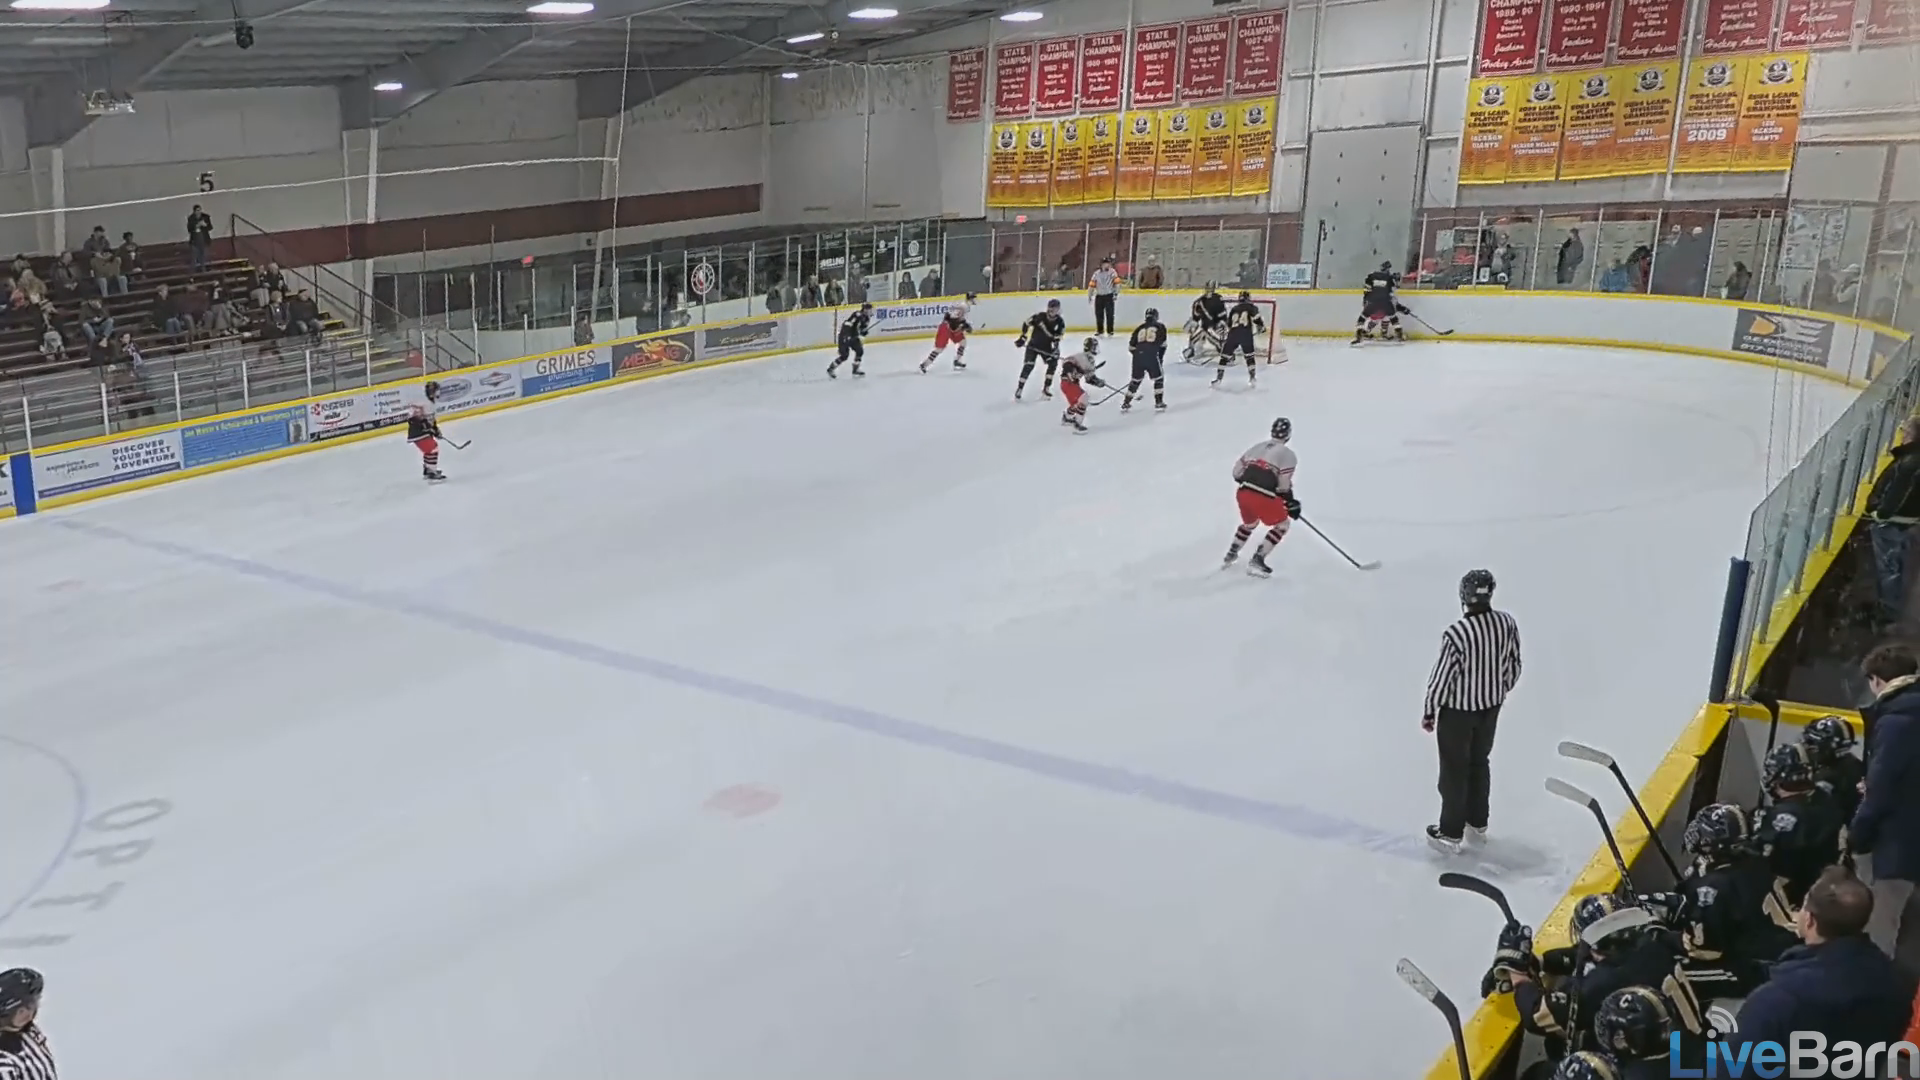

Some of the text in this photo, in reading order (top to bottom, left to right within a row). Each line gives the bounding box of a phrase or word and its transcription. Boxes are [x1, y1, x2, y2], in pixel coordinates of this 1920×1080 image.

[1247, 16, 1274, 27] STATE
[1196, 24, 1219, 33] STATE
[1239, 24, 1281, 38] CHAMPION
[1718, 21, 1756, 35] Jackson
[1146, 30, 1169, 41] STATE
[1188, 32, 1226, 44] CHAMPION
[1631, 29, 1666, 41] Jackson
[1782, 31, 1817, 42] Hockey
[1092, 36, 1114, 46] STATE
[1138, 40, 1176, 51] CHAMPION
[1561, 37, 1594, 50] Jackson
[1704, 38, 1738, 49] Hockey
[1004, 47, 1026, 57] STATE
[1046, 42, 1068, 52] STATE
[1085, 45, 1121, 56] CHAMPION
[1494, 42, 1524, 56] Jackson
[1040, 50, 1074, 61] CHAMPION
[1548, 53, 1577, 64] Hockey
[1480, 58, 1509, 69] Hockey
[200, 172, 215, 193] 5
[888, 304, 950, 319] certainte
[536, 350, 596, 374] GRIMES
[112, 439, 165, 455] DISCOVER
[113, 445, 172, 463] YOUR NEXT
[113, 452, 176, 471] ADVENTURE
